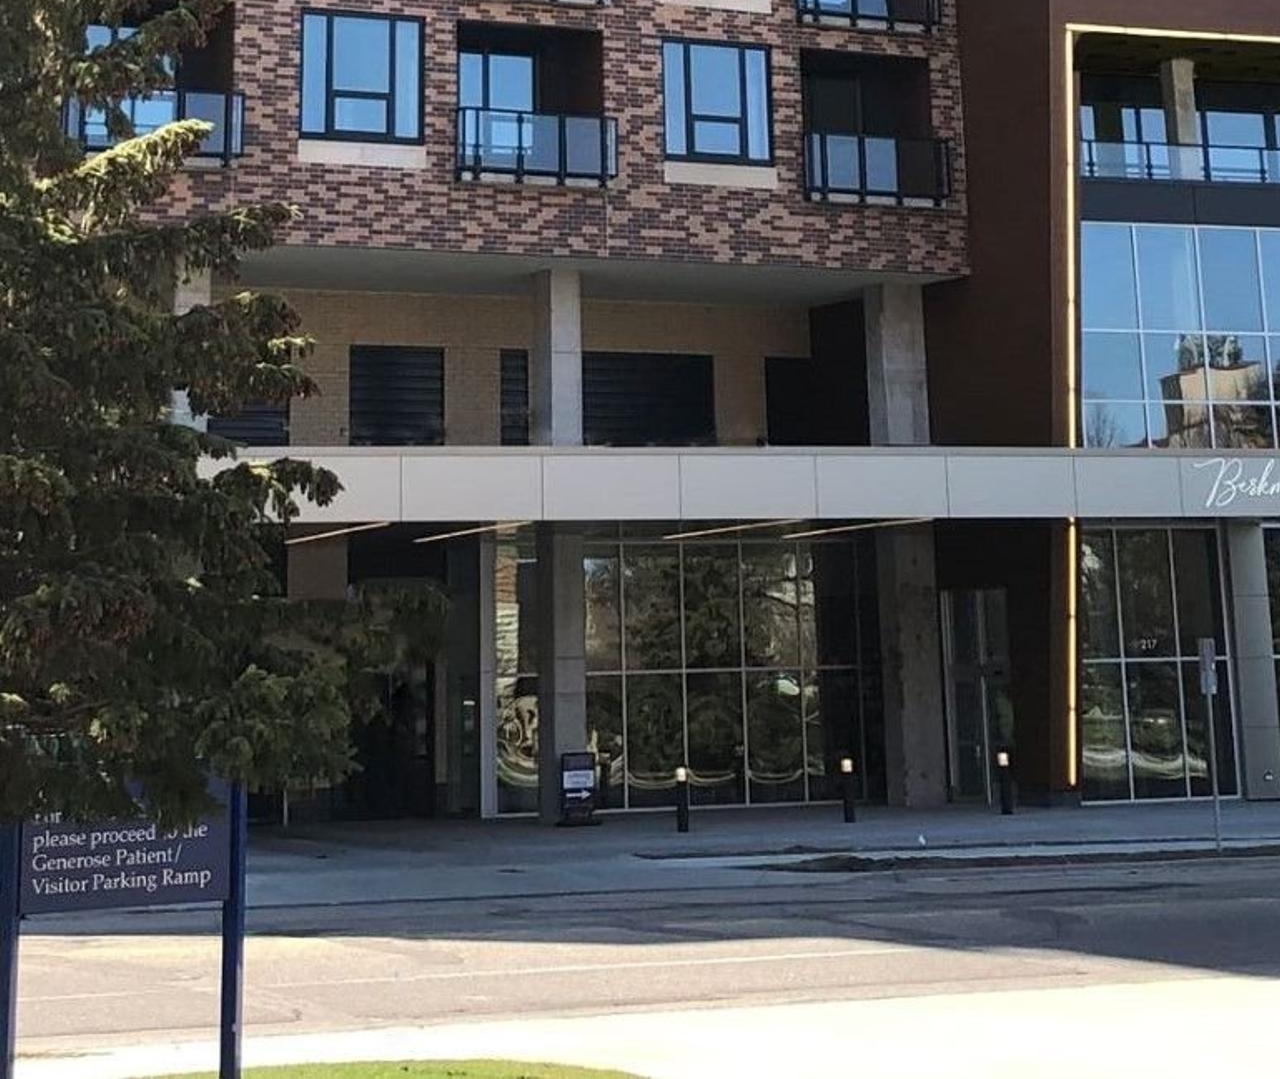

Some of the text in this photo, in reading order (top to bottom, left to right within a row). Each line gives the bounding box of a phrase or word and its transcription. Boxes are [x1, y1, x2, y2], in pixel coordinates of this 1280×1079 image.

[33, 830, 87, 853] please
[91, 824, 156, 849] proceed
[32, 844, 182, 872] Generose Patient/
[32, 868, 212, 895] Visitor Parking Ramp
